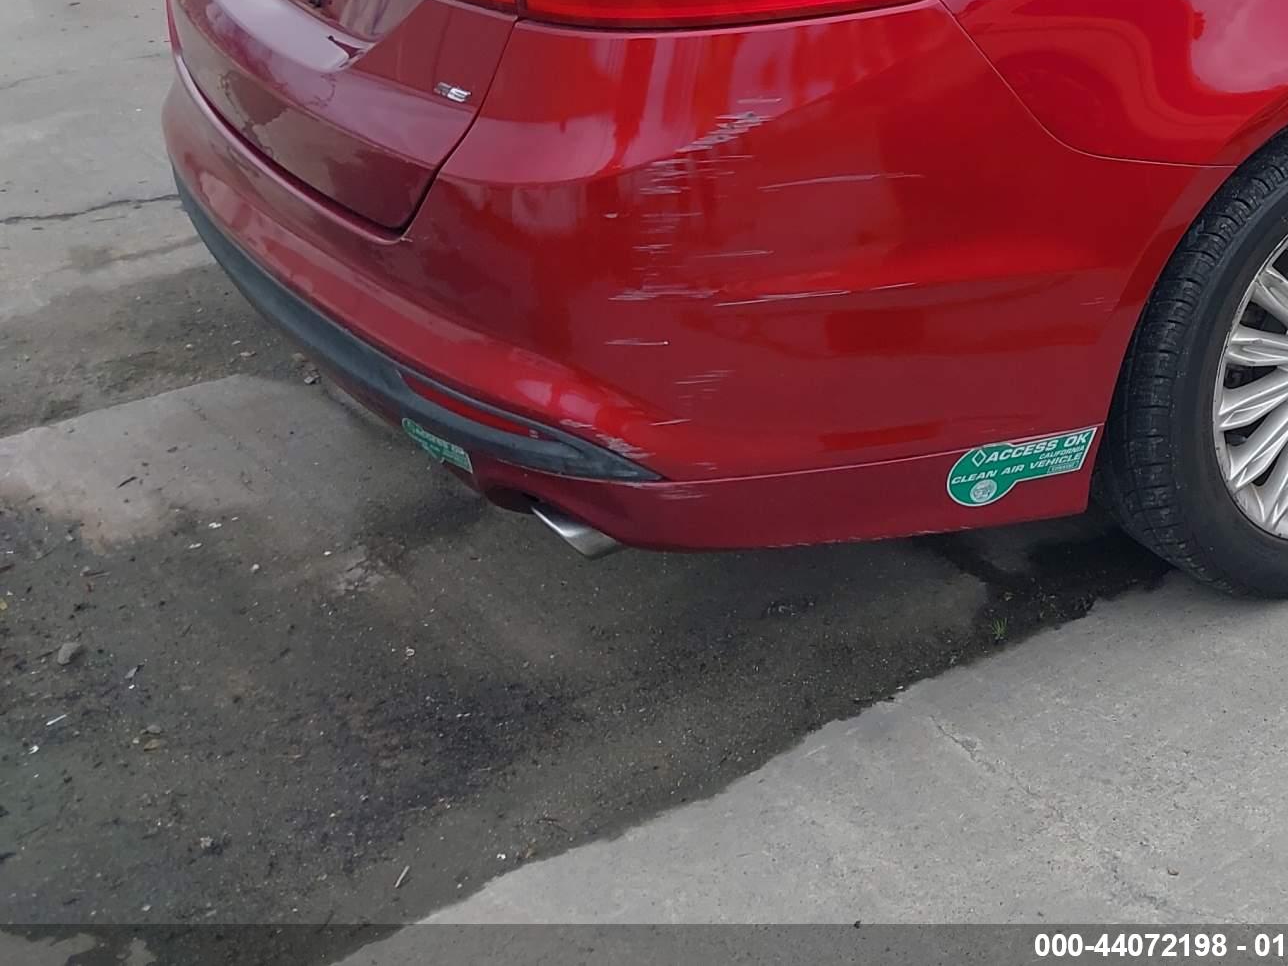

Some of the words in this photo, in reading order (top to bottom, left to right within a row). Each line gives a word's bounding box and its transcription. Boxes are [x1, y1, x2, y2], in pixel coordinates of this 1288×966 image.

[985, 440, 1060, 463] ACCESS
[1063, 432, 1090, 447] OK
[1039, 445, 1085, 460] CALIFORNIA
[950, 469, 998, 486] CLEAN
[1000, 463, 1026, 476] AIR
[1029, 452, 1083, 471] VEHICLE
